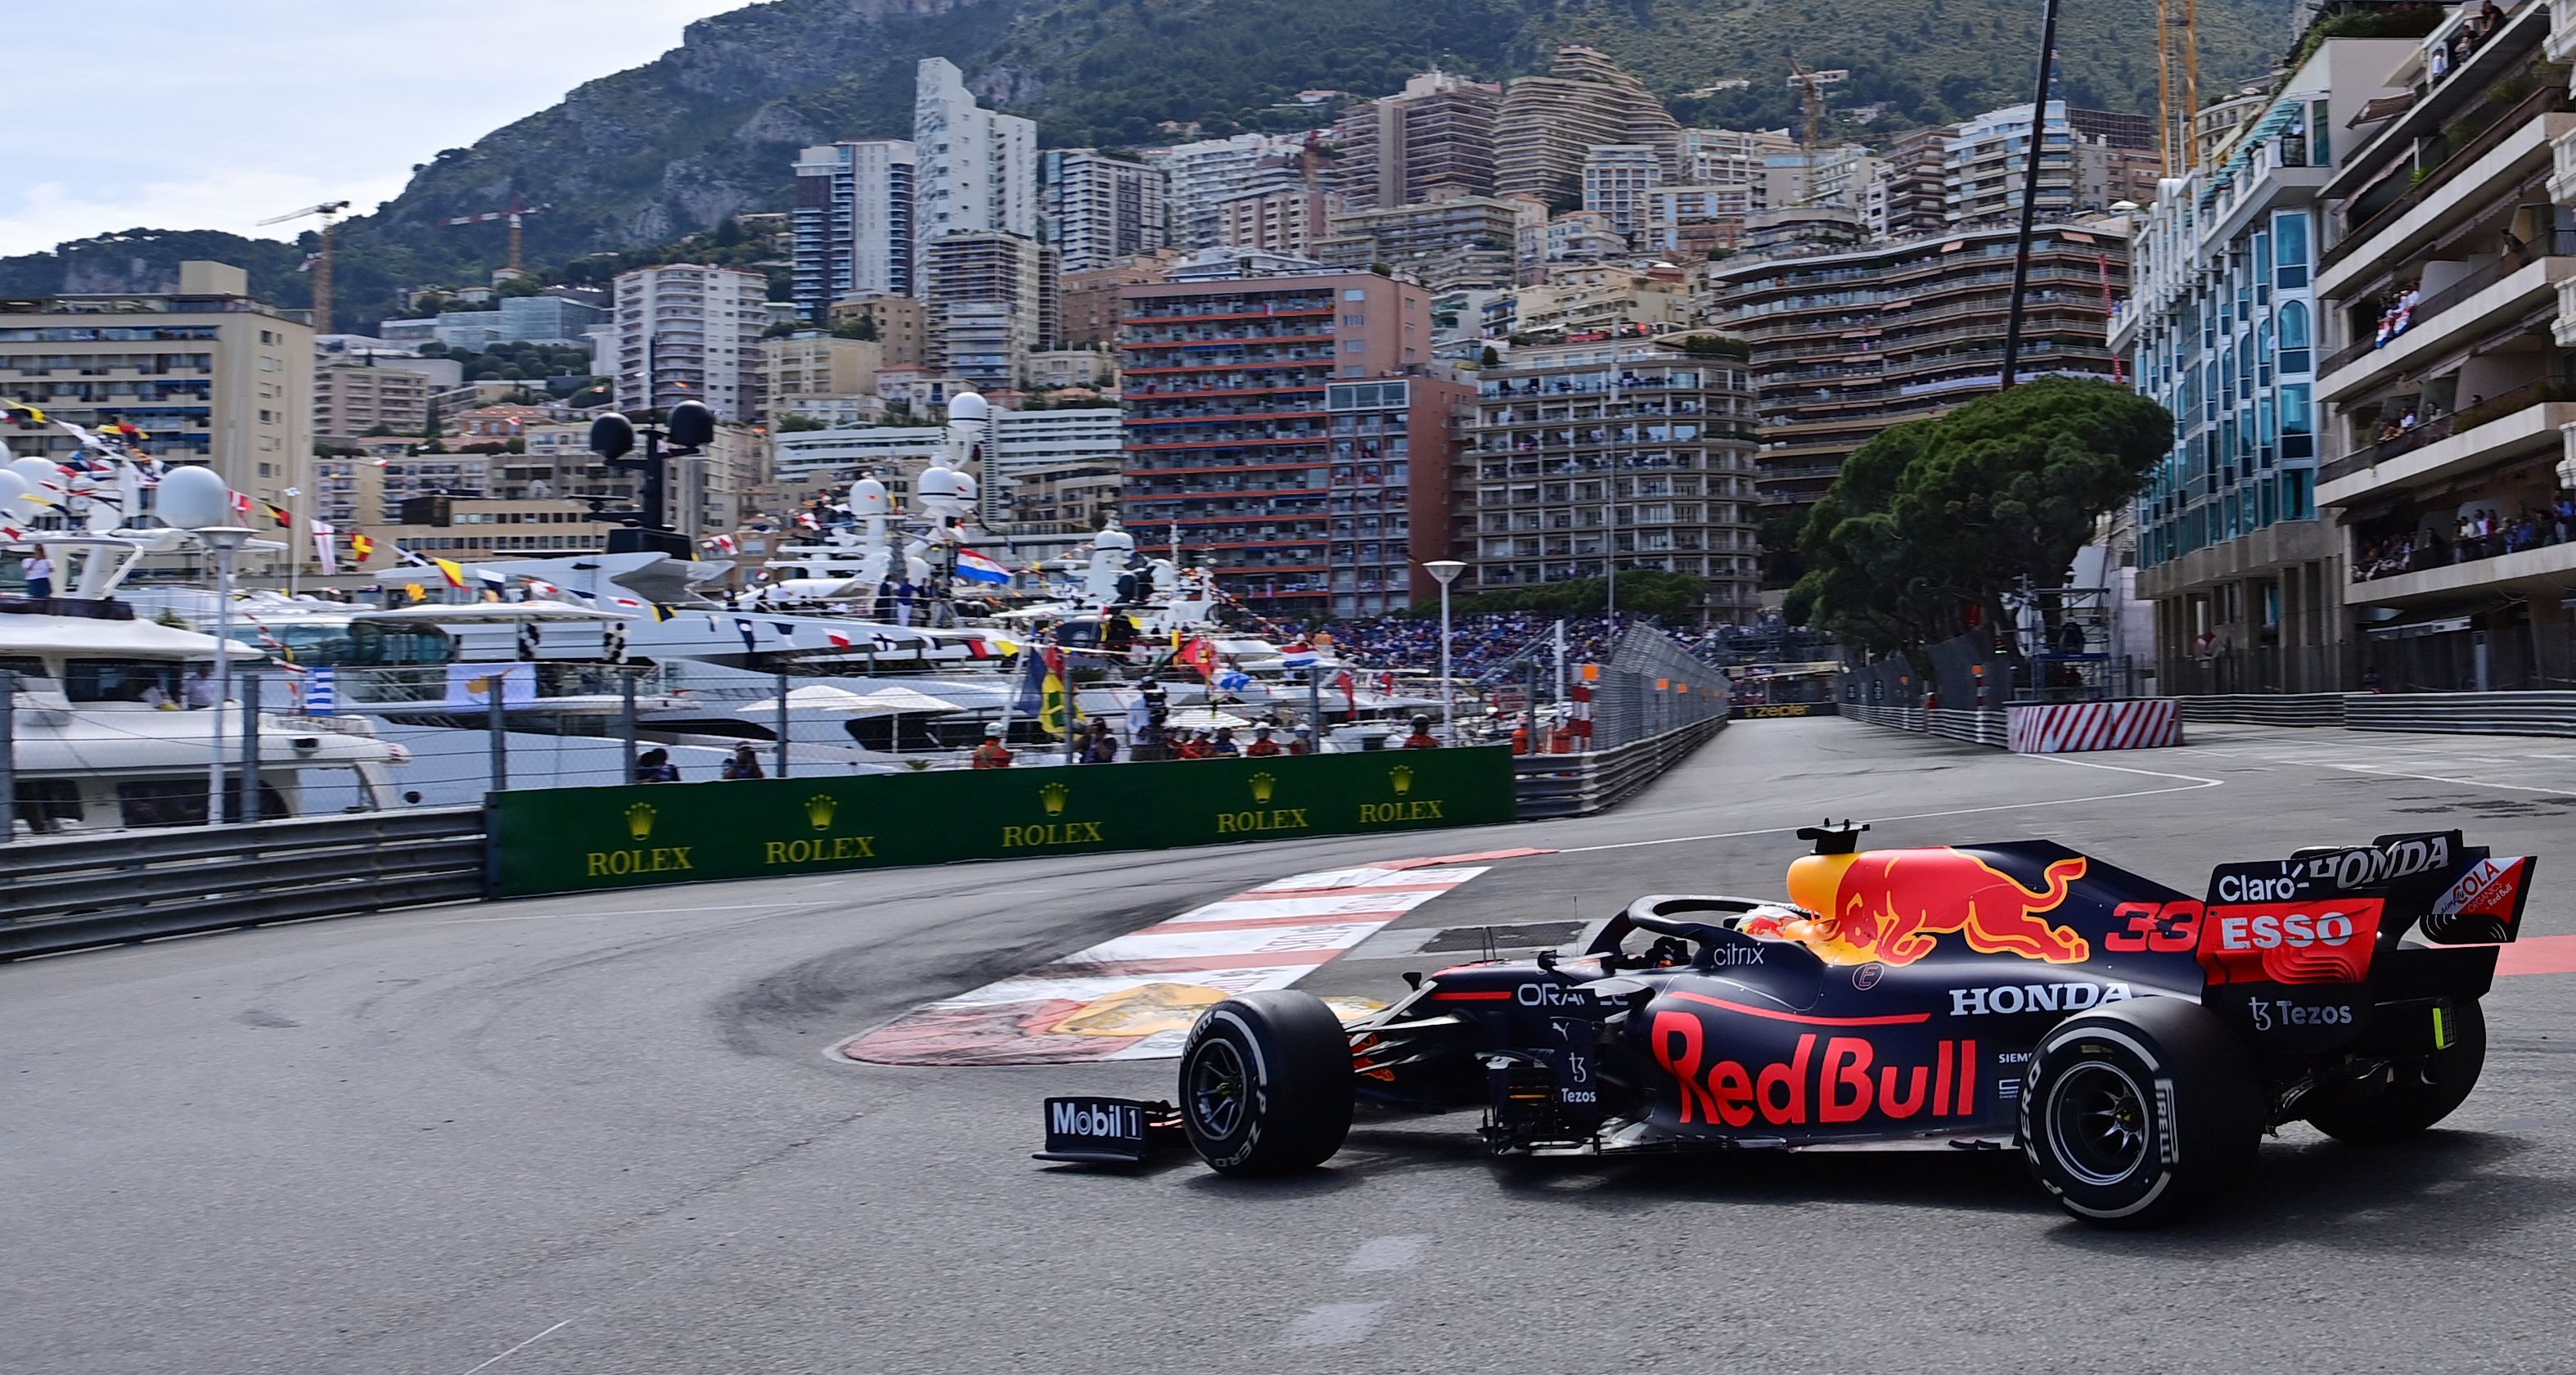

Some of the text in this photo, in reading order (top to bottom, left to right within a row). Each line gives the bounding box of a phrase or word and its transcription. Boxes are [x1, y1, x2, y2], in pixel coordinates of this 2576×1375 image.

[1217, 808, 1309, 833] ROLEX
[1359, 800, 1443, 823] ROLEX
[1002, 821, 1104, 848] ROLEX
[587, 846, 693, 877] ROLEX
[764, 836, 876, 864] ROLEX
[2218, 869, 2298, 901] Claro
[2105, 900, 2204, 952] 33
[2221, 911, 2353, 950] ESSO
[1714, 941, 1765, 966] citrix
[1517, 983, 1629, 1006] ORA
[1948, 982, 2134, 1017] HONDA
[2277, 1000, 2353, 1025] Tezos
[1998, 1053, 2033, 1064] SIEM
[1561, 1088, 1596, 1103] Tezos
[1052, 1102, 1121, 1137] Mobil
[2020, 1059, 2042, 1166] ZERO
[2154, 1078, 2179, 1164] PIRELLI
[1214, 1120, 1262, 1167] ZERO
